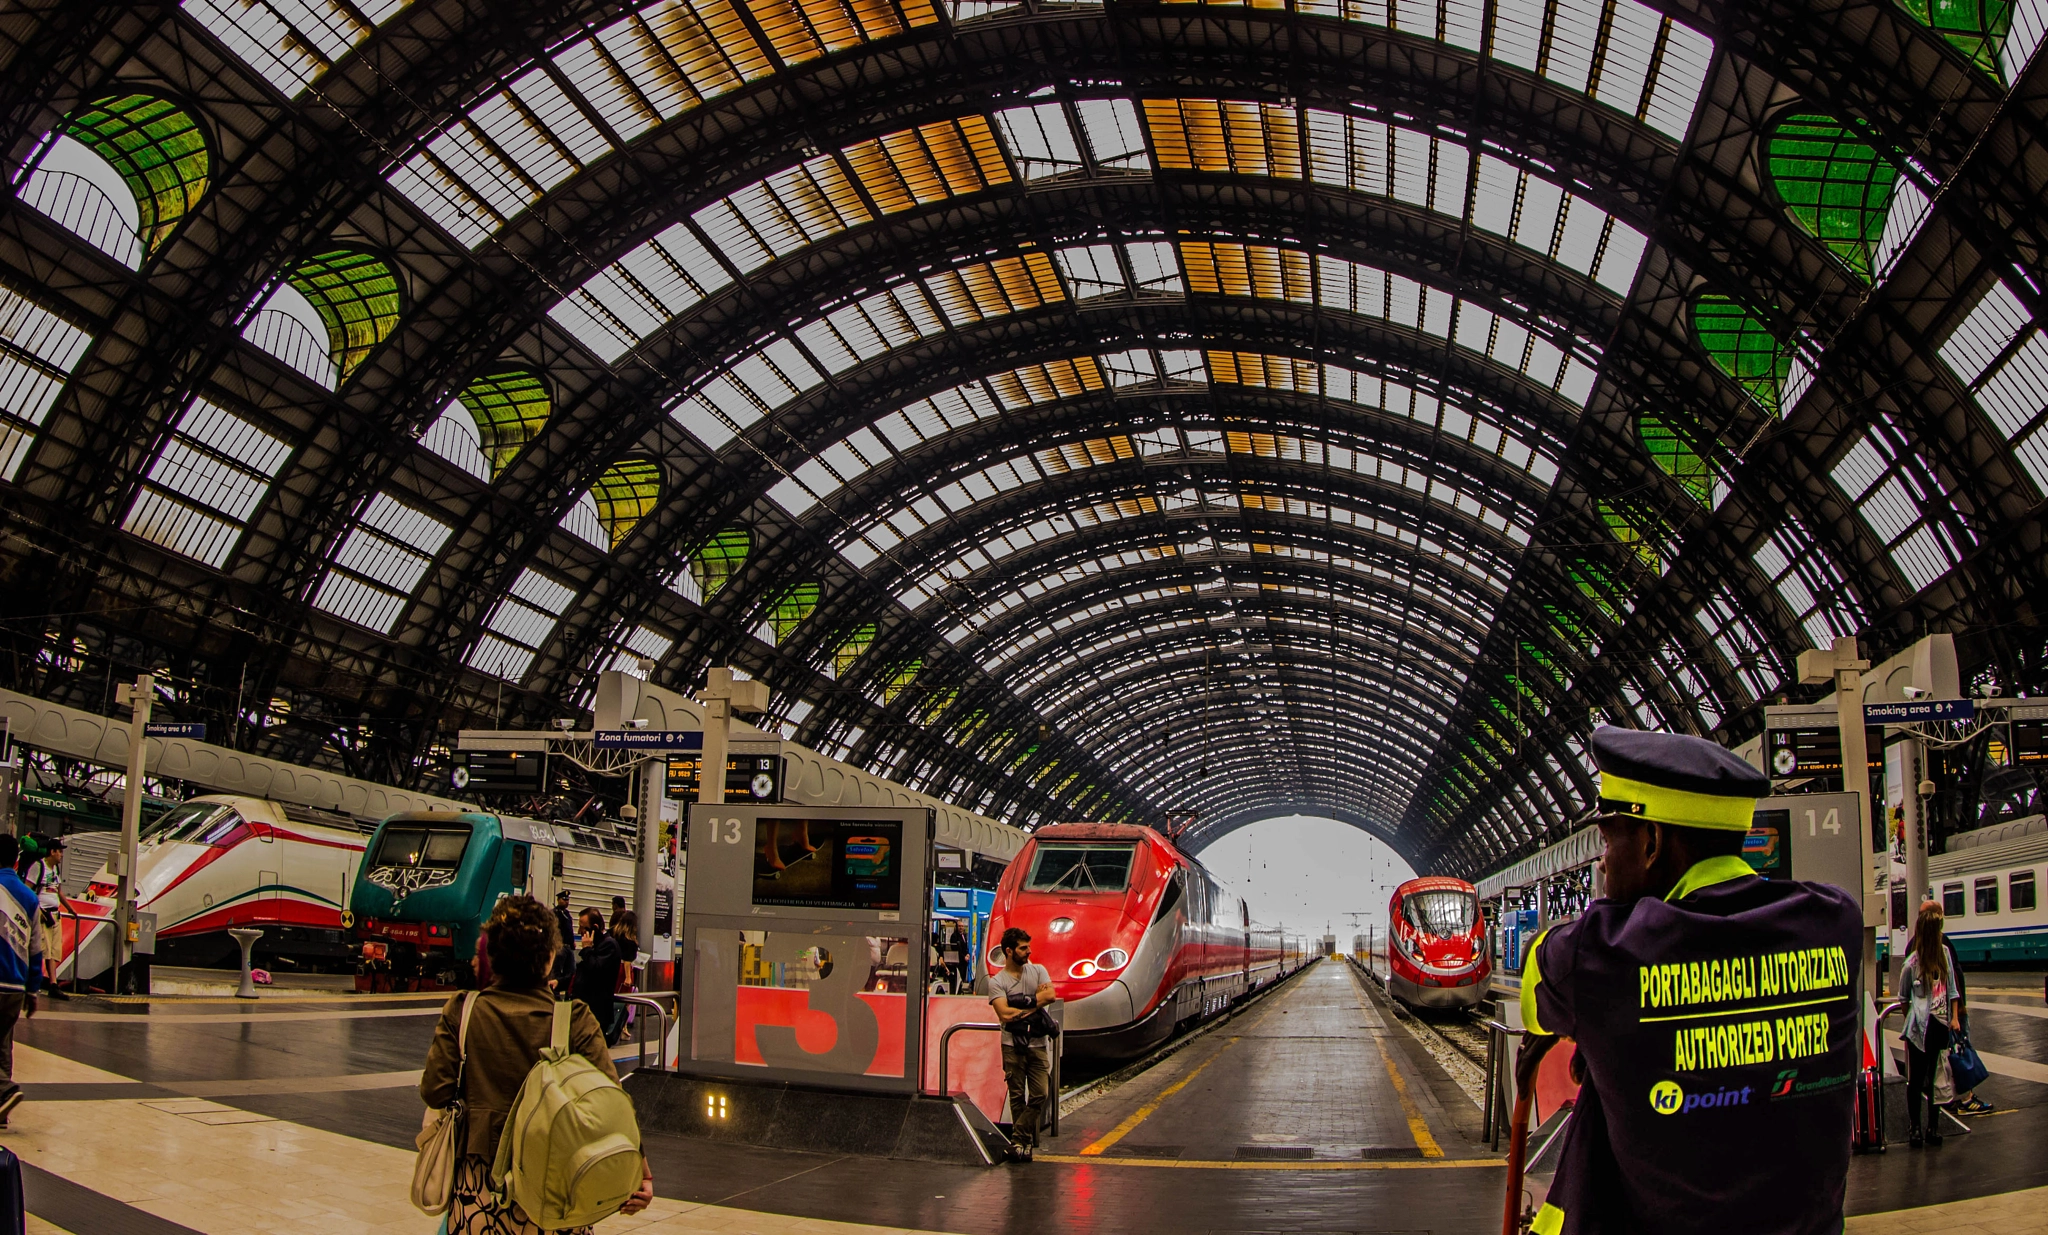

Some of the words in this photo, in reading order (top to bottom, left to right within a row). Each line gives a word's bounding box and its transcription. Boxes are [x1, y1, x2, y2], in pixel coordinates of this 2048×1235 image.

[1867, 705, 1907, 716] Smoking
[1909, 706, 1931, 714] area
[146, 724, 167, 734] Smoking
[599, 733, 621, 742] Zona
[623, 732, 661, 742] fumatori
[1775, 732, 1786, 745] 14
[760, 759, 770, 770] 13
[30, 795, 76, 811] TRENORD
[1804, 807, 1842, 837] 14
[708, 817, 742, 845] 13
[847, 866, 854, 875] 6
[139, 919, 152, 933] 12
[1639, 956, 1757, 1009] PORTABAGAGLI
[1760, 946, 1849, 997] AUTORIZZATO
[1675, 1020, 1774, 1072] AUTHORIZED
[1775, 1012, 1830, 1061] PORTER
[1654, 1089, 1678, 1110] ki
[1683, 1086, 1750, 1114] point
